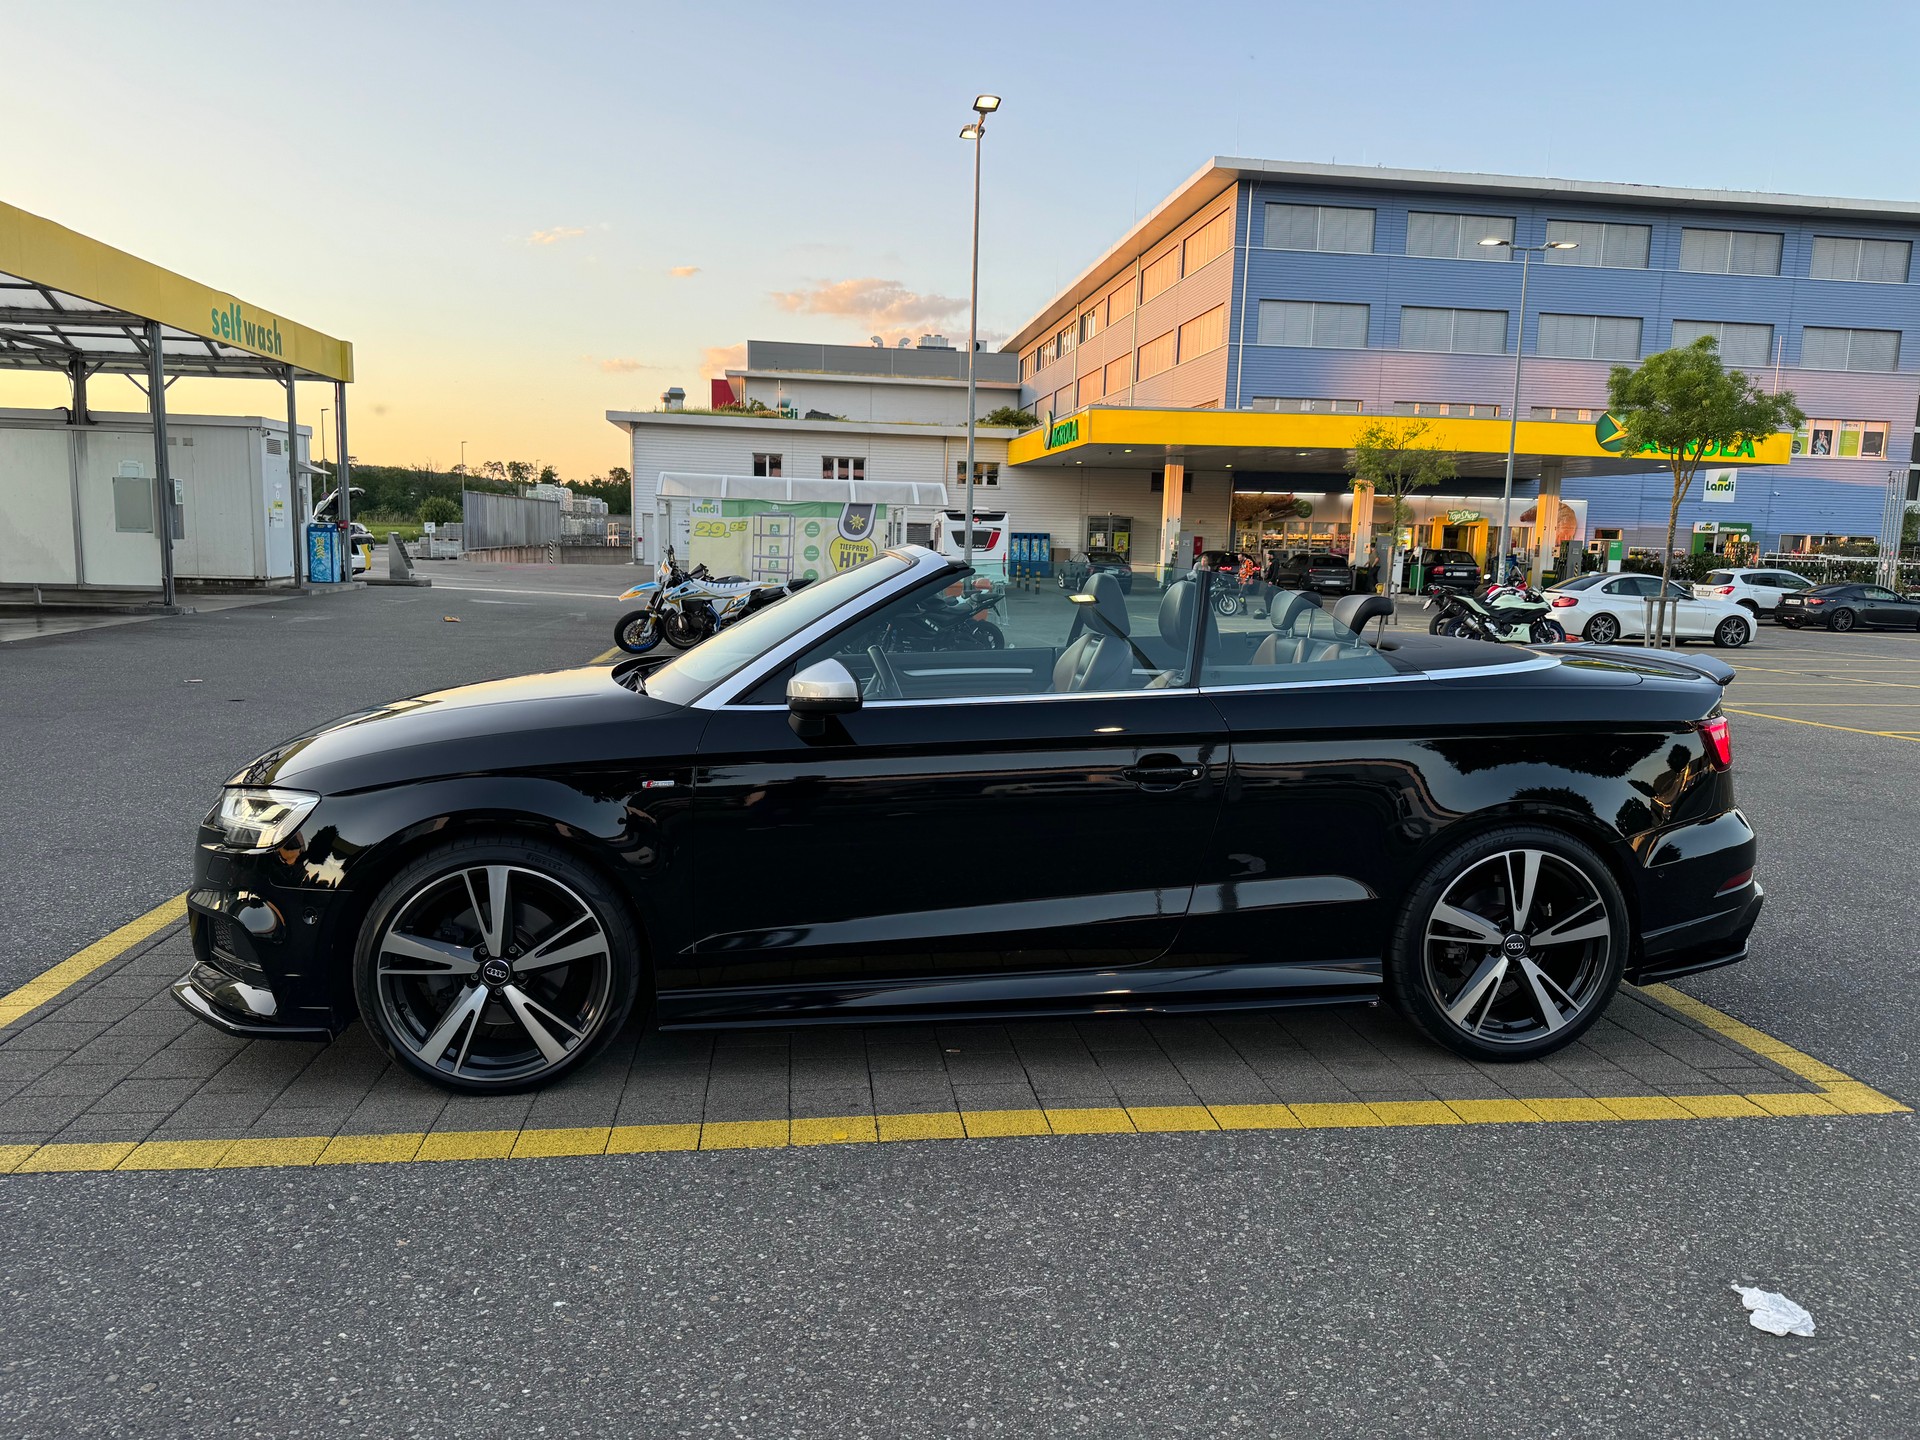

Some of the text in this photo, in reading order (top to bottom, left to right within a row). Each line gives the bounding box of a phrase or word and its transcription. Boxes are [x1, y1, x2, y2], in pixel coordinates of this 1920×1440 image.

[1052, 419, 1078, 448] AGROLA
[1706, 480, 1735, 492] Landi
[692, 503, 719, 514] Landi
[840, 543, 869, 552] TIEFPREIS
[839, 551, 868, 568] HIT
